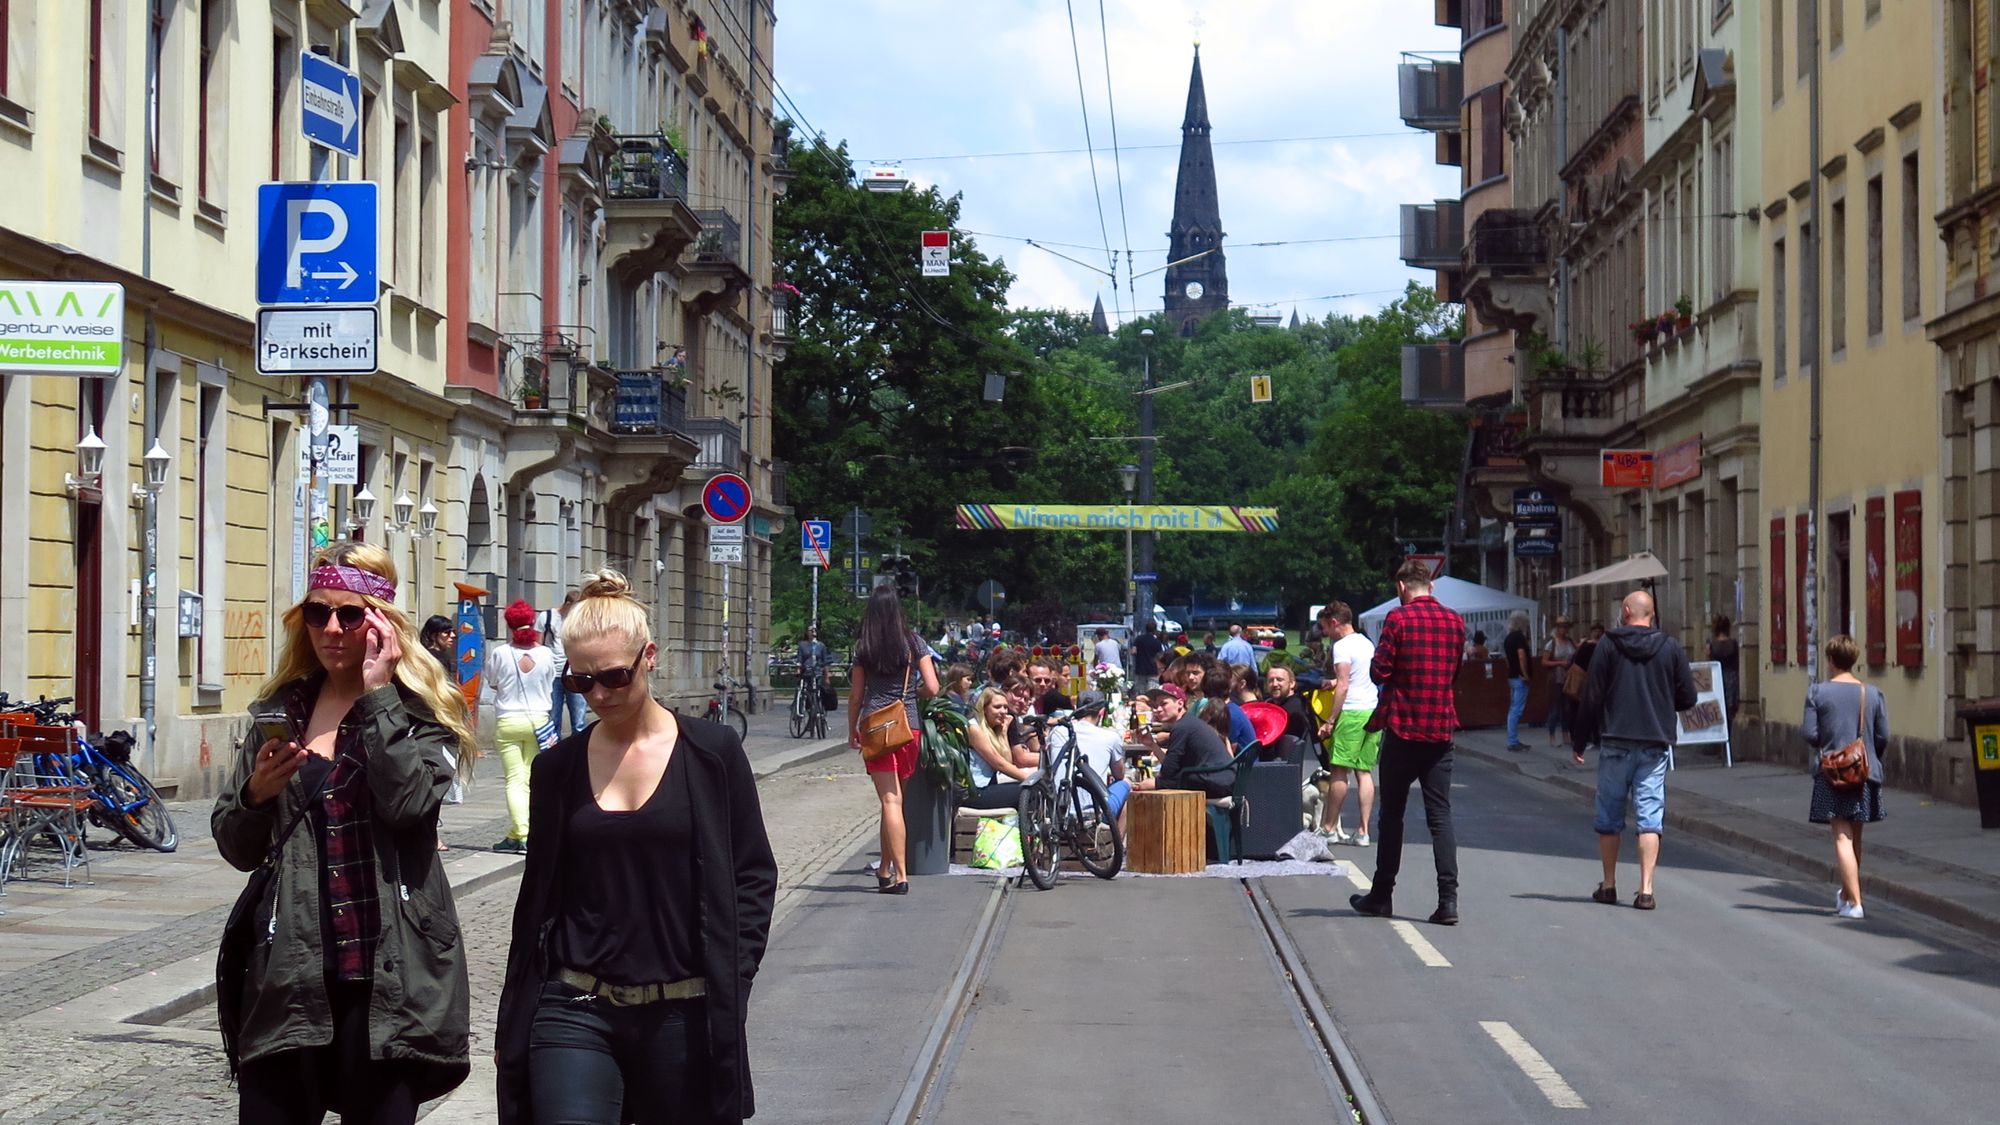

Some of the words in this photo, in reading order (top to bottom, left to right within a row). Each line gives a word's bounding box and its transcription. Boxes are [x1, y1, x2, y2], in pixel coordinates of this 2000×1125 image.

[305, 85, 344, 119] Einbahnstraße
[286, 199, 349, 288] P
[63, 322, 114, 336] weise
[303, 322, 332, 339] mit
[0, 343, 106, 361] Werbetechnik
[268, 342, 368, 360] Parkschein
[1013, 506, 1081, 528] Nimm
[1087, 506, 1143, 528] mich
[809, 524, 824, 546] P
[463, 599, 473, 614] P
